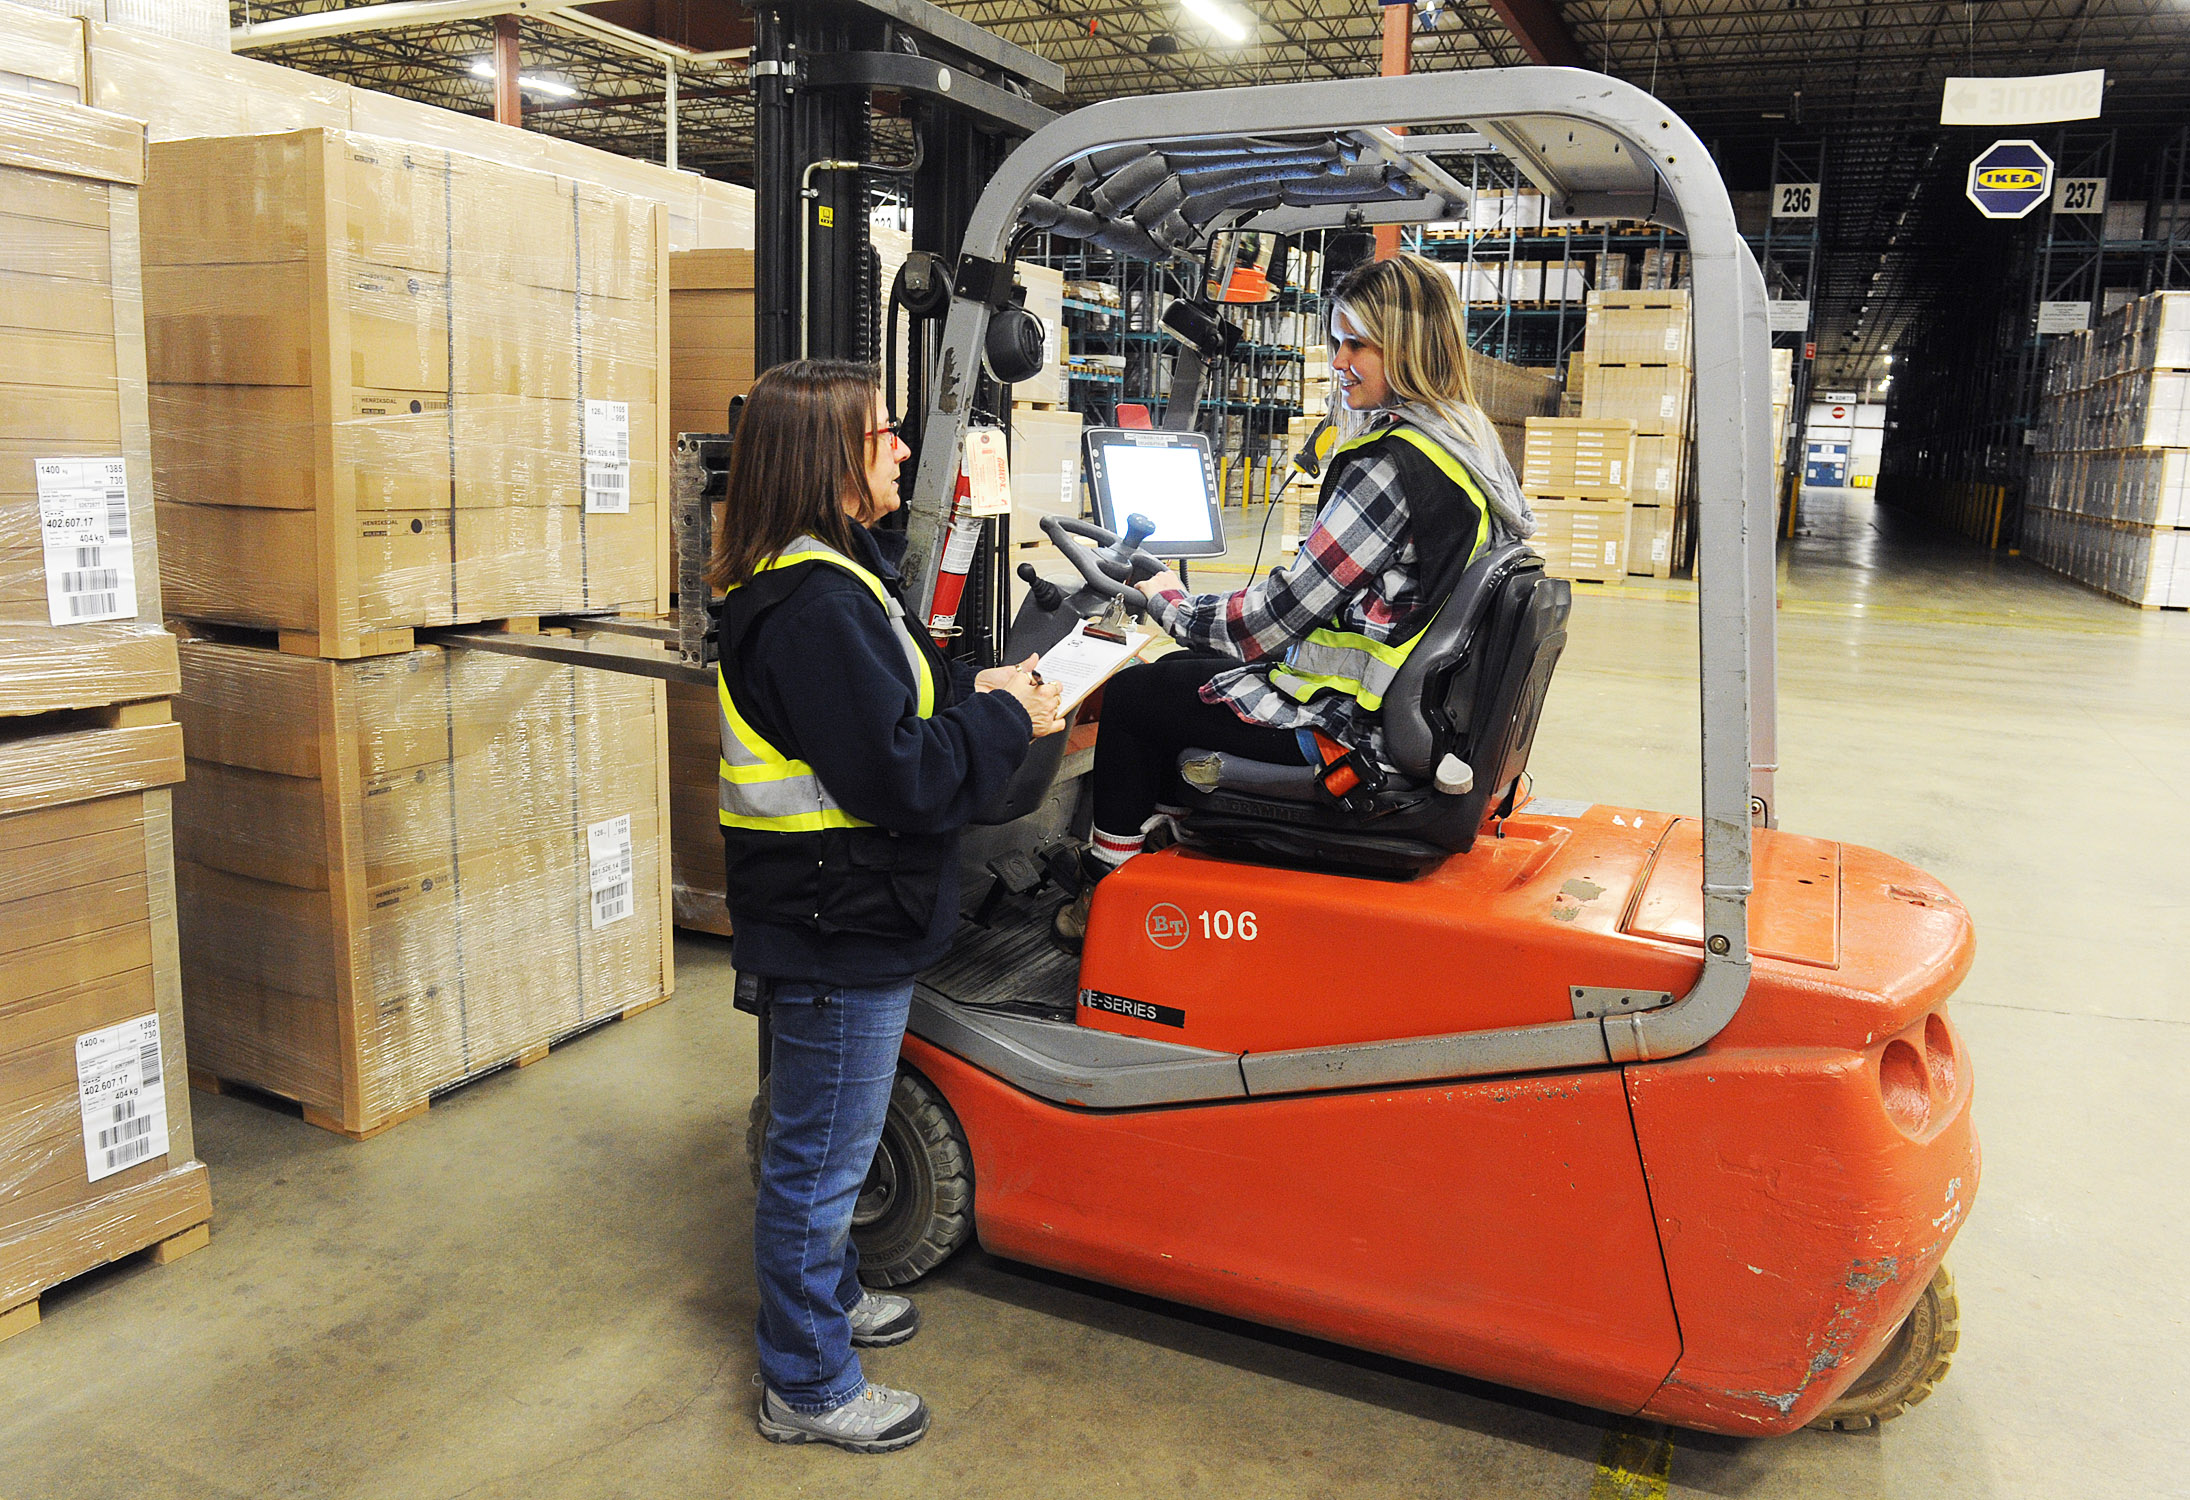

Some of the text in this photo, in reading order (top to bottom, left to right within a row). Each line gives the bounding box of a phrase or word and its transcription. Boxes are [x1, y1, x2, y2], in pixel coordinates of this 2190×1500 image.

[1986, 174, 2035, 183] IKEA
[1782, 187, 1811, 213] 236
[2064, 182, 2098, 209] 237
[41, 465, 60, 474] 1400
[105, 464, 123, 473] 1385
[109, 476, 123, 485] 730
[46, 517, 94, 528] 402.607.17
[80, 534, 94, 542] 404
[95, 533, 104, 544] kg
[1198, 909, 1258, 941] 106
[139, 1019, 157, 1030] 1385
[144, 1030, 157, 1039] 730
[80, 1037, 98, 1048] 1400
[84, 1074, 128, 1096] 402.607.17
[115, 1086, 139, 1100] 404 kg
